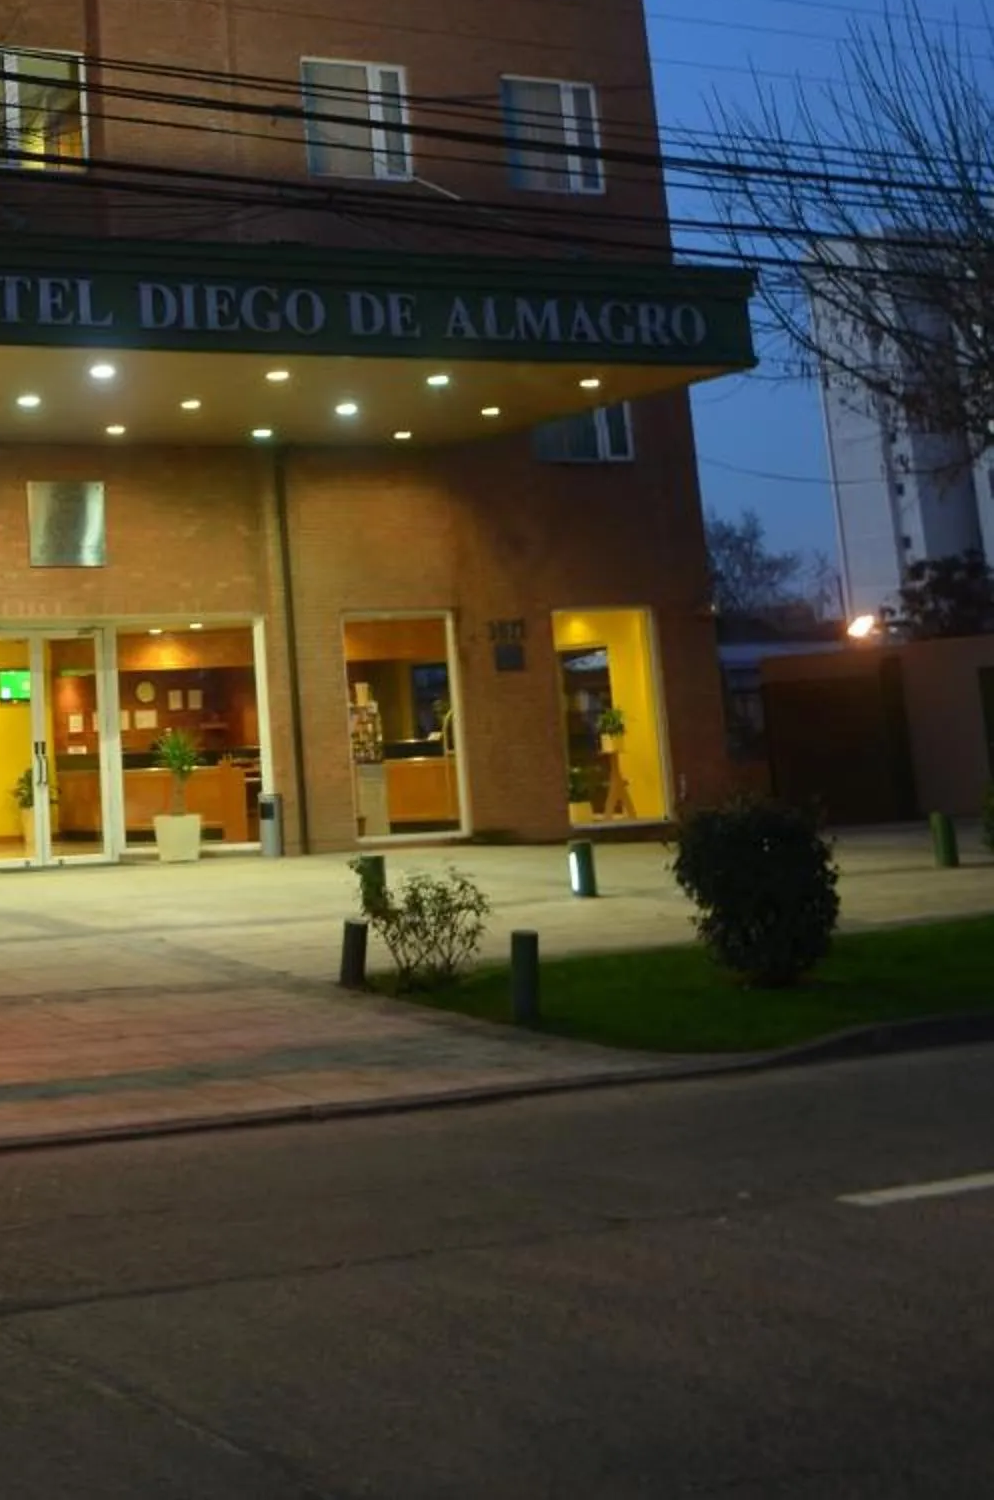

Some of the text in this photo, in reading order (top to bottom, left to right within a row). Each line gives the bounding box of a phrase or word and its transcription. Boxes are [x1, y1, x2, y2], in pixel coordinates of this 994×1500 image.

[138, 281, 326, 335] DIEGO
[346, 290, 422, 338] DE
[441, 295, 707, 346] ALMAGRO
